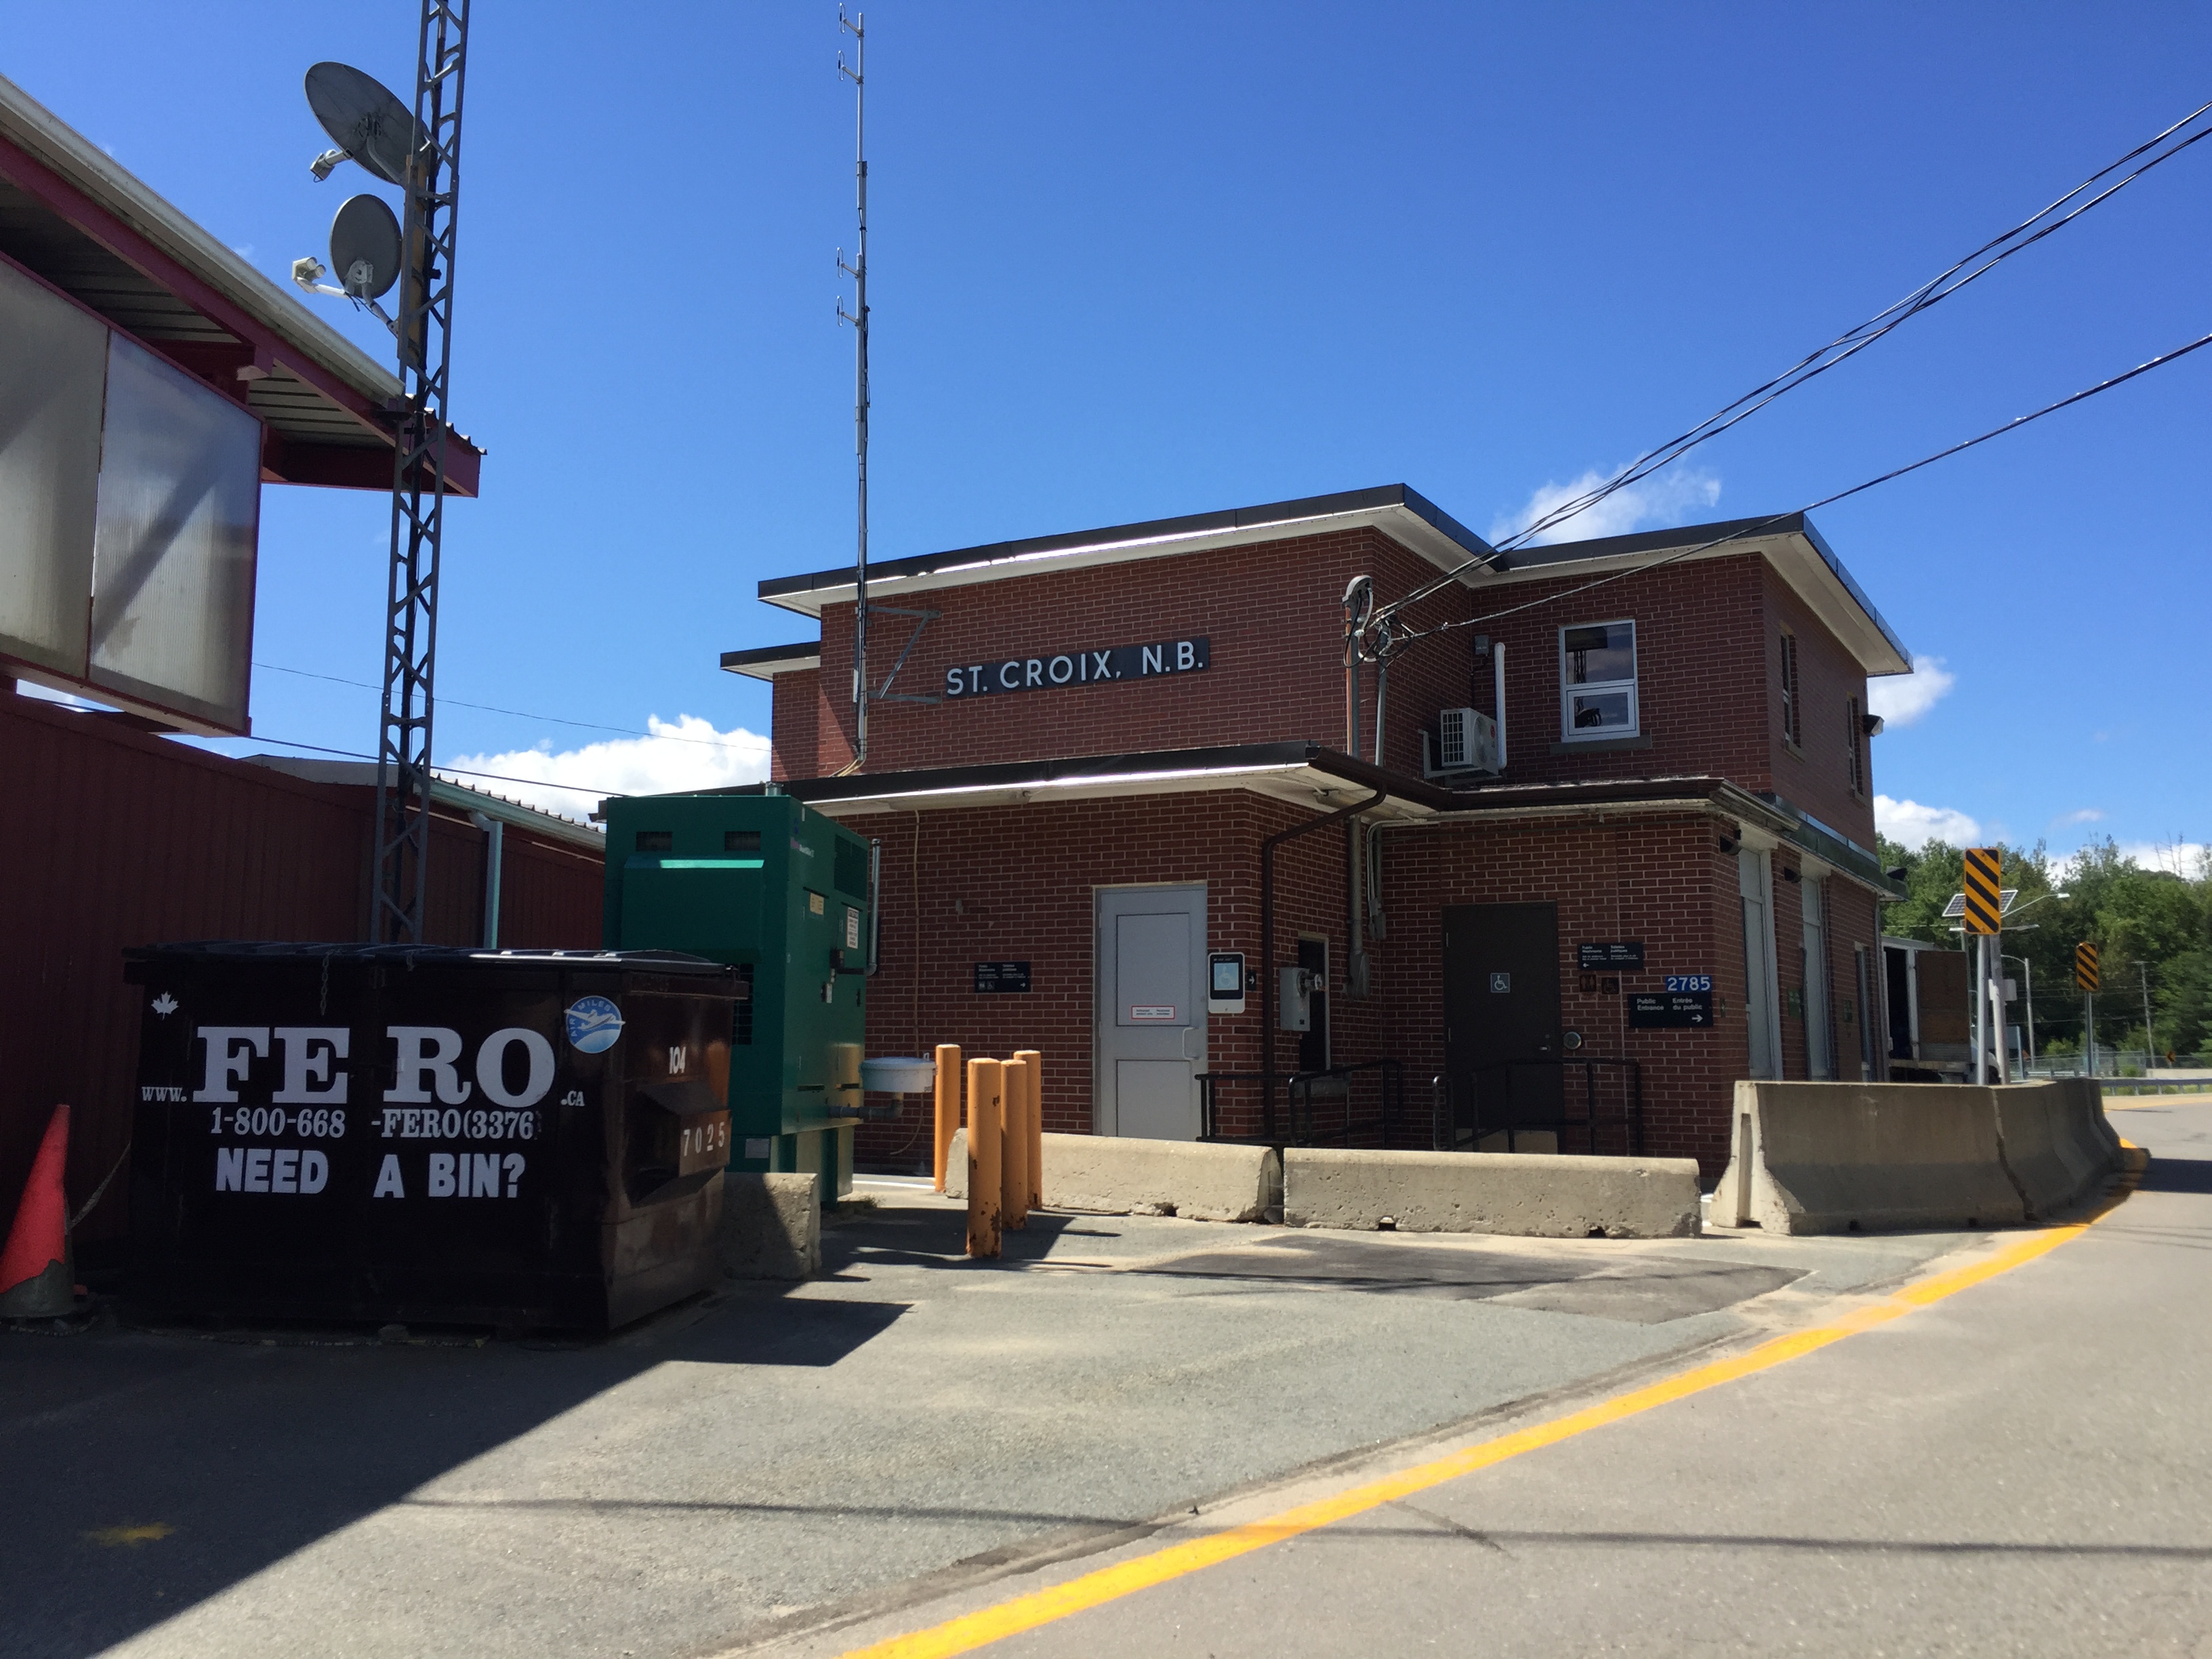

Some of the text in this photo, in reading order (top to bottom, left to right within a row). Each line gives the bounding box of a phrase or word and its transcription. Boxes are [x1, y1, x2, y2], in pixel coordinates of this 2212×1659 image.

[947, 665, 988, 695] ST.
[1000, 650, 1122, 688] CROIX,
[1667, 977, 1711, 991] 2785
[569, 1000, 612, 1037] AIR MILES
[669, 1046, 687, 1075] 104
[211, 1107, 346, 1138] 1-800-668
[216, 1147, 526, 1198] NEED A BIN?
